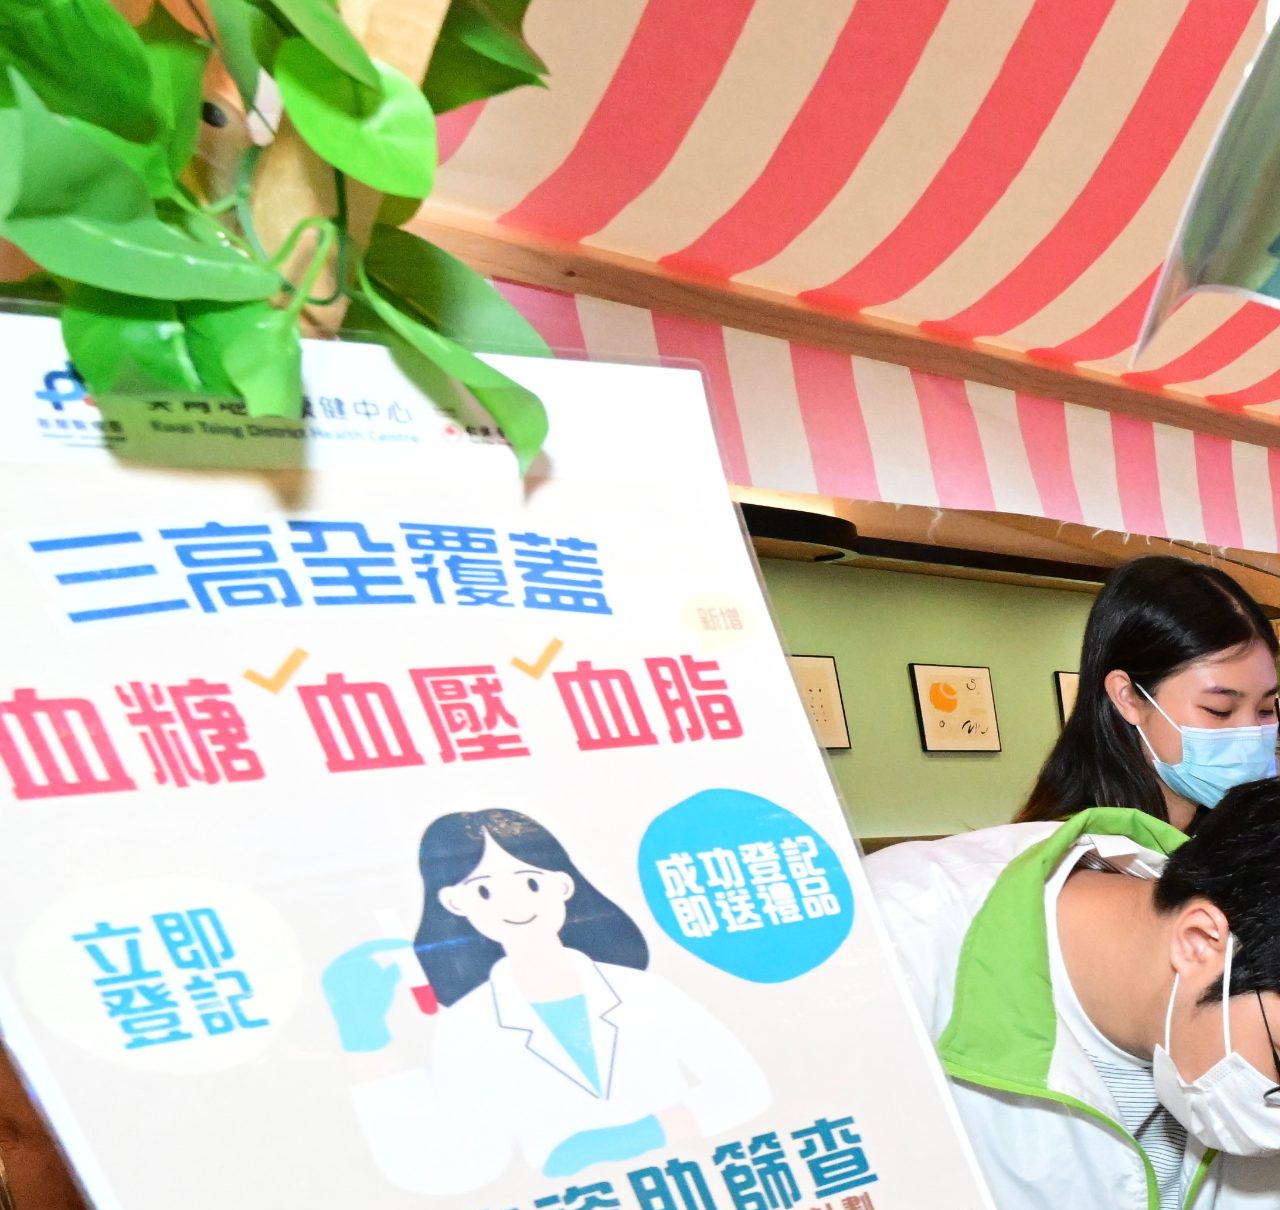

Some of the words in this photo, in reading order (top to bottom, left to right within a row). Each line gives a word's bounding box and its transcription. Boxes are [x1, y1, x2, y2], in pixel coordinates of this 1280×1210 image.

[28, 520, 613, 623] 三高全覆蓋
[0, 678, 266, 801] 血糖
[296, 664, 531, 772] 血壓
[553, 654, 744, 751] 血脂
[655, 836, 827, 900] 成功登記
[72, 906, 236, 986] 立即
[675, 876, 842, 940] 即送禮品
[102, 973, 269, 1050] 登記
